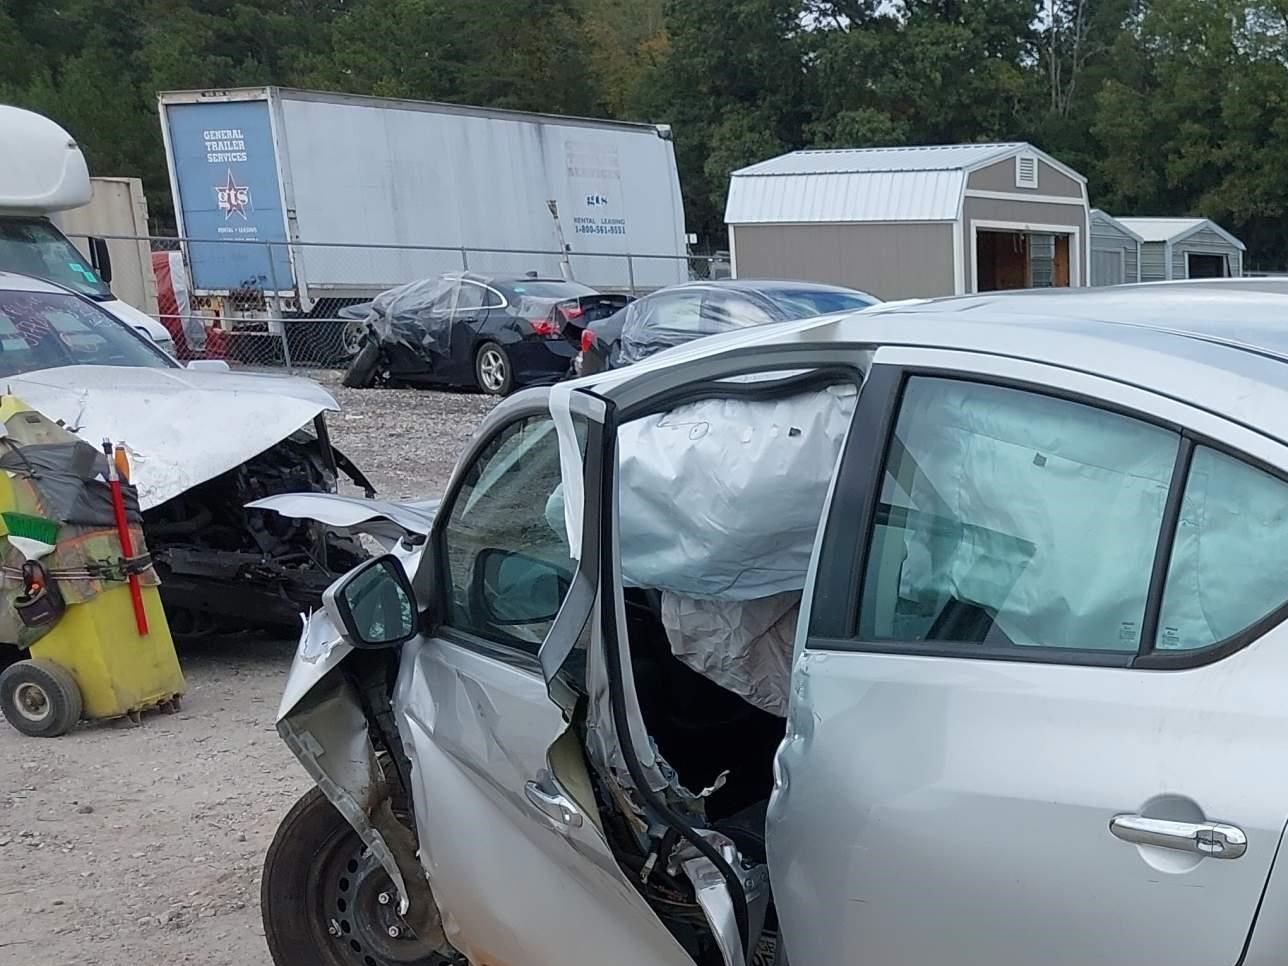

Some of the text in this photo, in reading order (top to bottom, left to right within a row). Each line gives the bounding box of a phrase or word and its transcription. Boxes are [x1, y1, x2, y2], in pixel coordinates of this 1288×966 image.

[203, 130, 244, 140] GENERAL
[205, 140, 245, 151] TRAILER
[207, 152, 247, 162] SERVICES
[218, 188, 249, 210] gts
